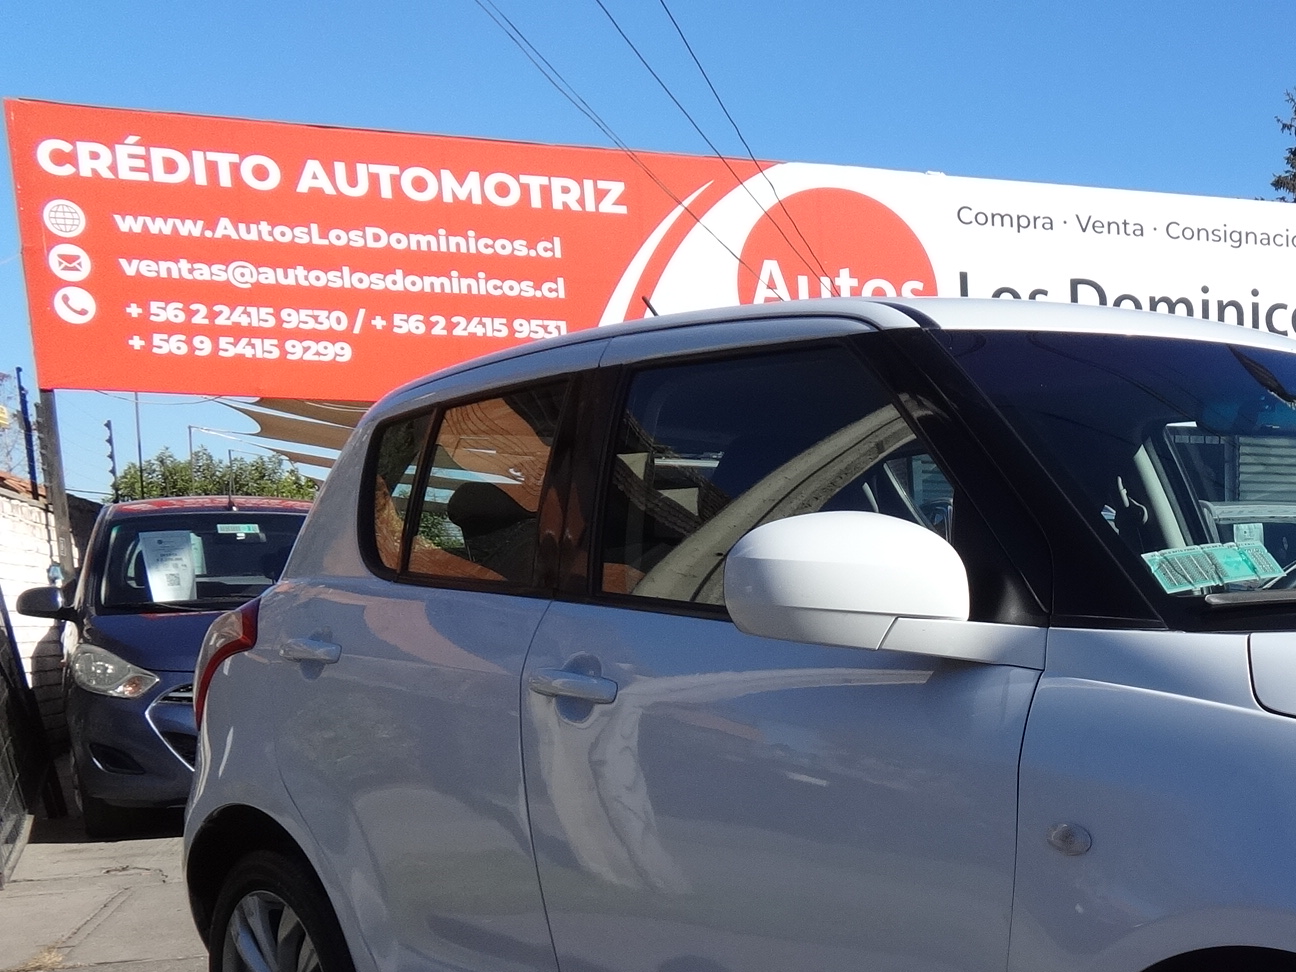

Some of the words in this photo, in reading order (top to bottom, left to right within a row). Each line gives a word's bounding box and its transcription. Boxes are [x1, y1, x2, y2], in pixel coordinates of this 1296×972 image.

[36, 135, 282, 191] CRÉDITO
[295, 159, 628, 215] AUTOMOTRIZ
[112, 213, 562, 258] www.AutosLosDominicos.cl
[956, 205, 1055, 233] Compra
[1075, 213, 1145, 238] Venta
[118, 257, 566, 299] ventas@autoslosdominicos.cl
[125, 303, 143, 318] +
[149, 301, 186, 324] 56
[189, 303, 210, 325] 2
[213, 304, 276, 328] 2415
[280, 307, 348, 332] 9530
[371, 315, 387, 331] +
[392, 313, 426, 335] 56
[429, 315, 448, 336] 2
[451, 315, 509, 338] 2415
[512, 318, 567, 339] 9531
[128, 335, 146, 350] +
[152, 333, 189, 356] 56
[192, 335, 213, 357] 9
[218, 336, 281, 360] 5415
[284, 339, 353, 363] 9299
